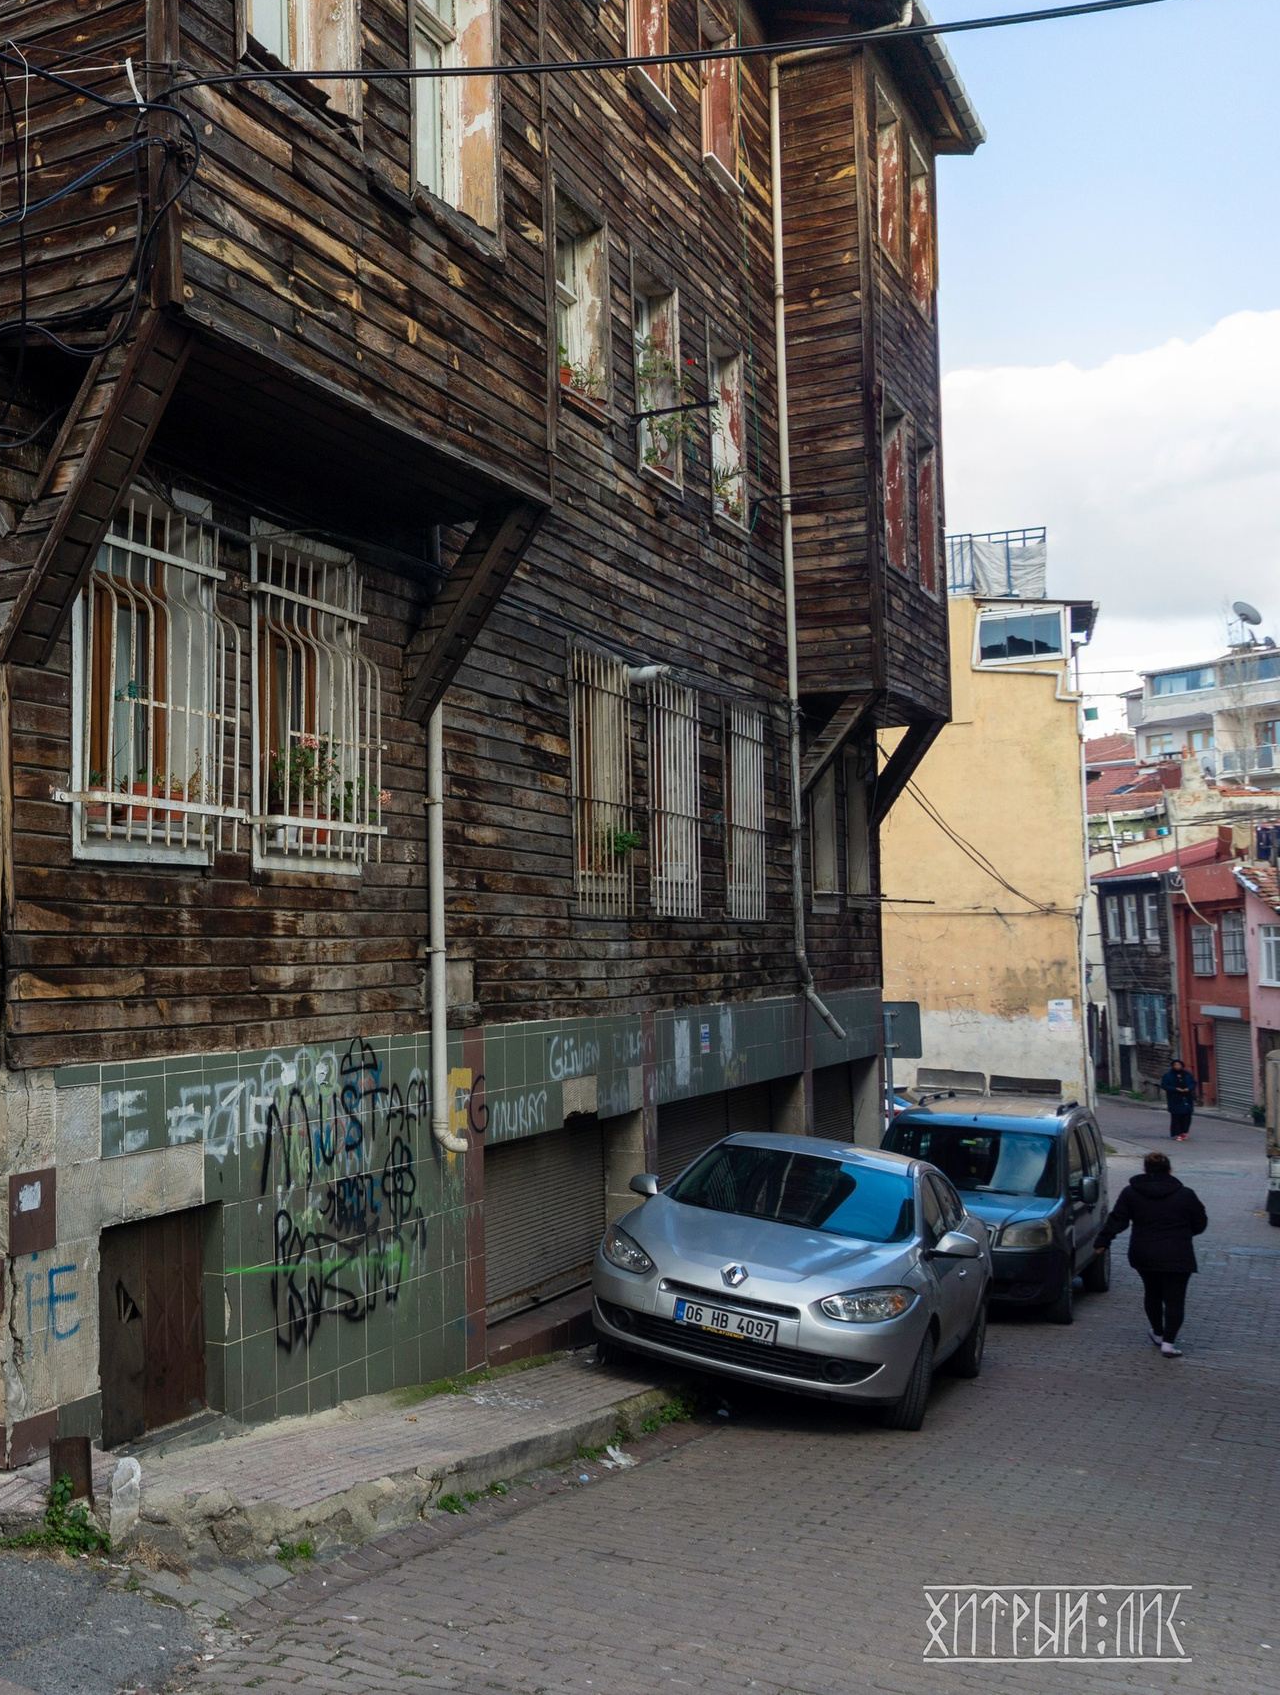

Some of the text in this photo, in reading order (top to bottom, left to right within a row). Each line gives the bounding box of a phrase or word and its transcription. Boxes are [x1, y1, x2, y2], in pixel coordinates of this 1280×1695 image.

[491, 1090, 548, 1138] MURAT
[686, 1305, 704, 1322] 06
[710, 1310, 729, 1329] HB
[736, 1317, 774, 1340] 4097
